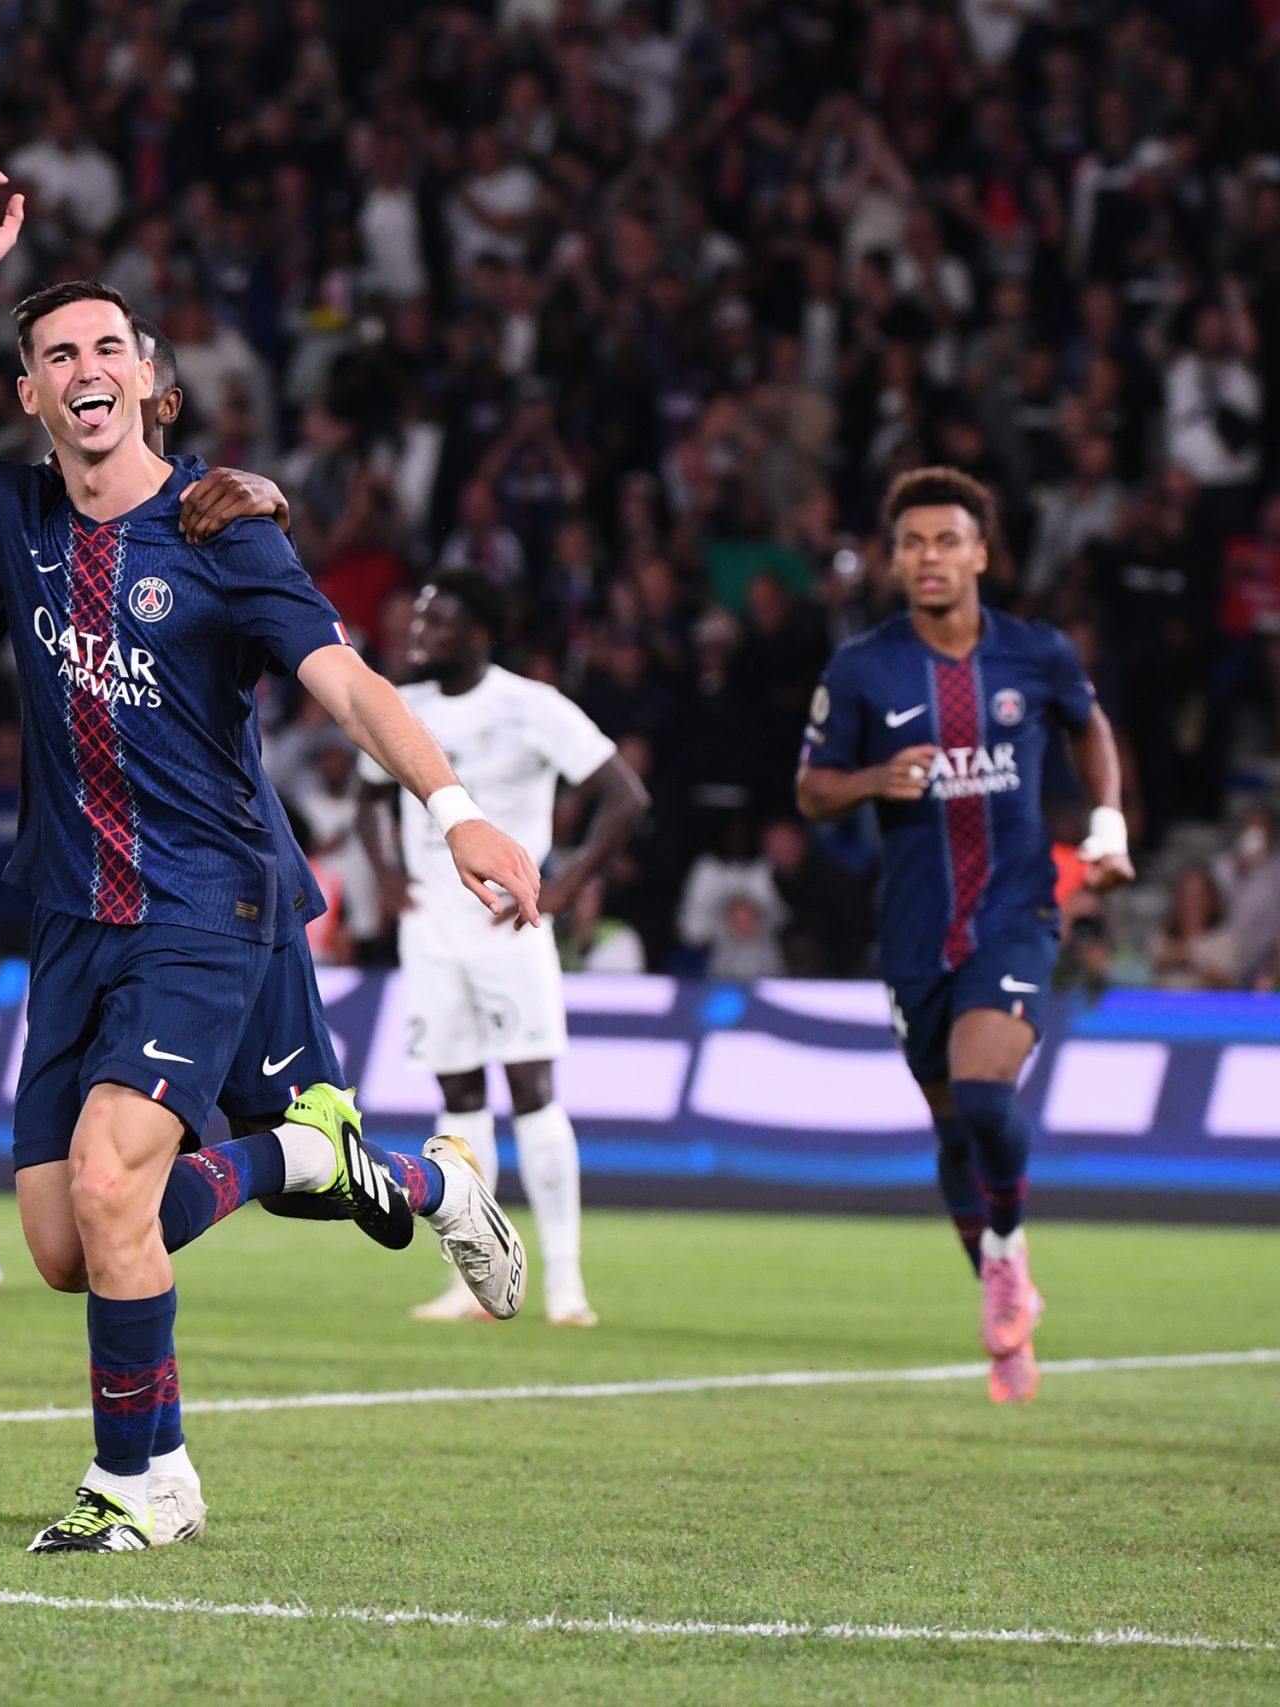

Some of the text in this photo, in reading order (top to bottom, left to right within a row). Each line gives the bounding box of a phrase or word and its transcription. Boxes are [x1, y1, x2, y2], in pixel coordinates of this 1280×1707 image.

[33, 605, 158, 687] QATAR
[57, 657, 162, 709] AIRWAYS
[927, 742, 1018, 781] ATAR
